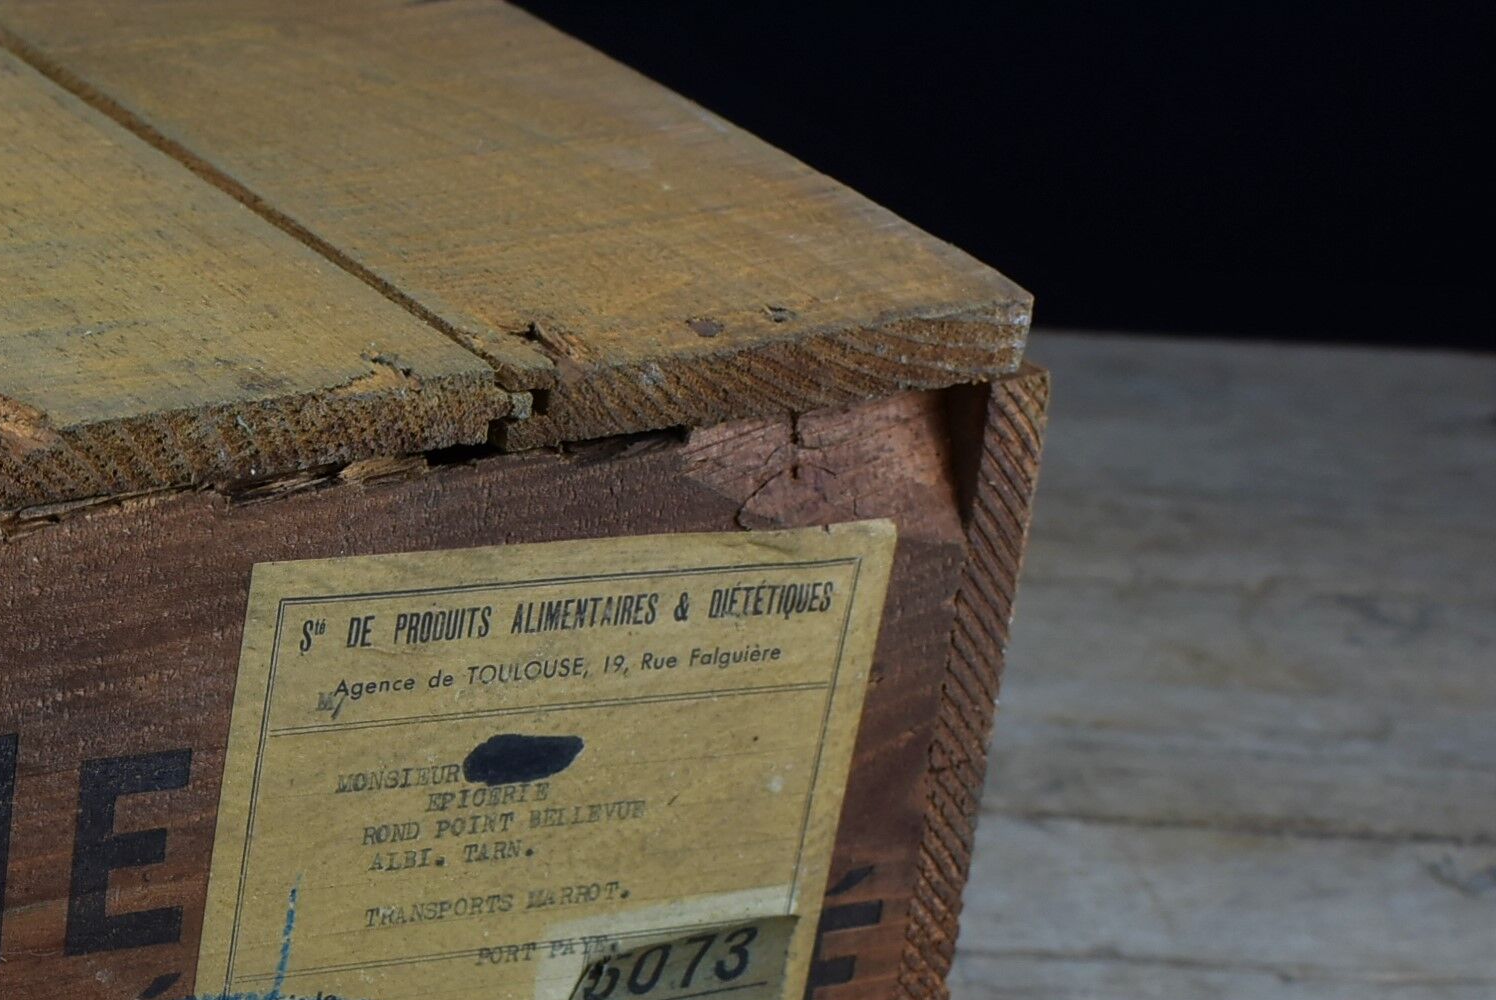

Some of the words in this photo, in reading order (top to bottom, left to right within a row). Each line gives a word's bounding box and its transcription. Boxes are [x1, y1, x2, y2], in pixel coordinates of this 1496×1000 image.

[347, 615, 375, 648] DE
[394, 605, 492, 645] PRODUITS
[510, 592, 658, 634] ALIMENTAIRES
[673, 592, 690, 622] &
[708, 580, 834, 620] DIÉTÉTIQUES
[333, 679, 416, 700] Agence
[428, 669, 454, 688] de
[467, 656, 589, 685] TOULOUSE,
[603, 654, 629, 675] 19,
[641, 652, 677, 671] Rue
[689, 644, 781, 669] Falguière
[335, 763, 460, 794] MONSIEUR
[425, 782, 551, 813] EPICERIE
[362, 821, 420, 847] ROND
[434, 811, 516, 840] POINT
[529, 800, 646, 830] BELLEVUE
[365, 893, 514, 928] TRANSPORTS
